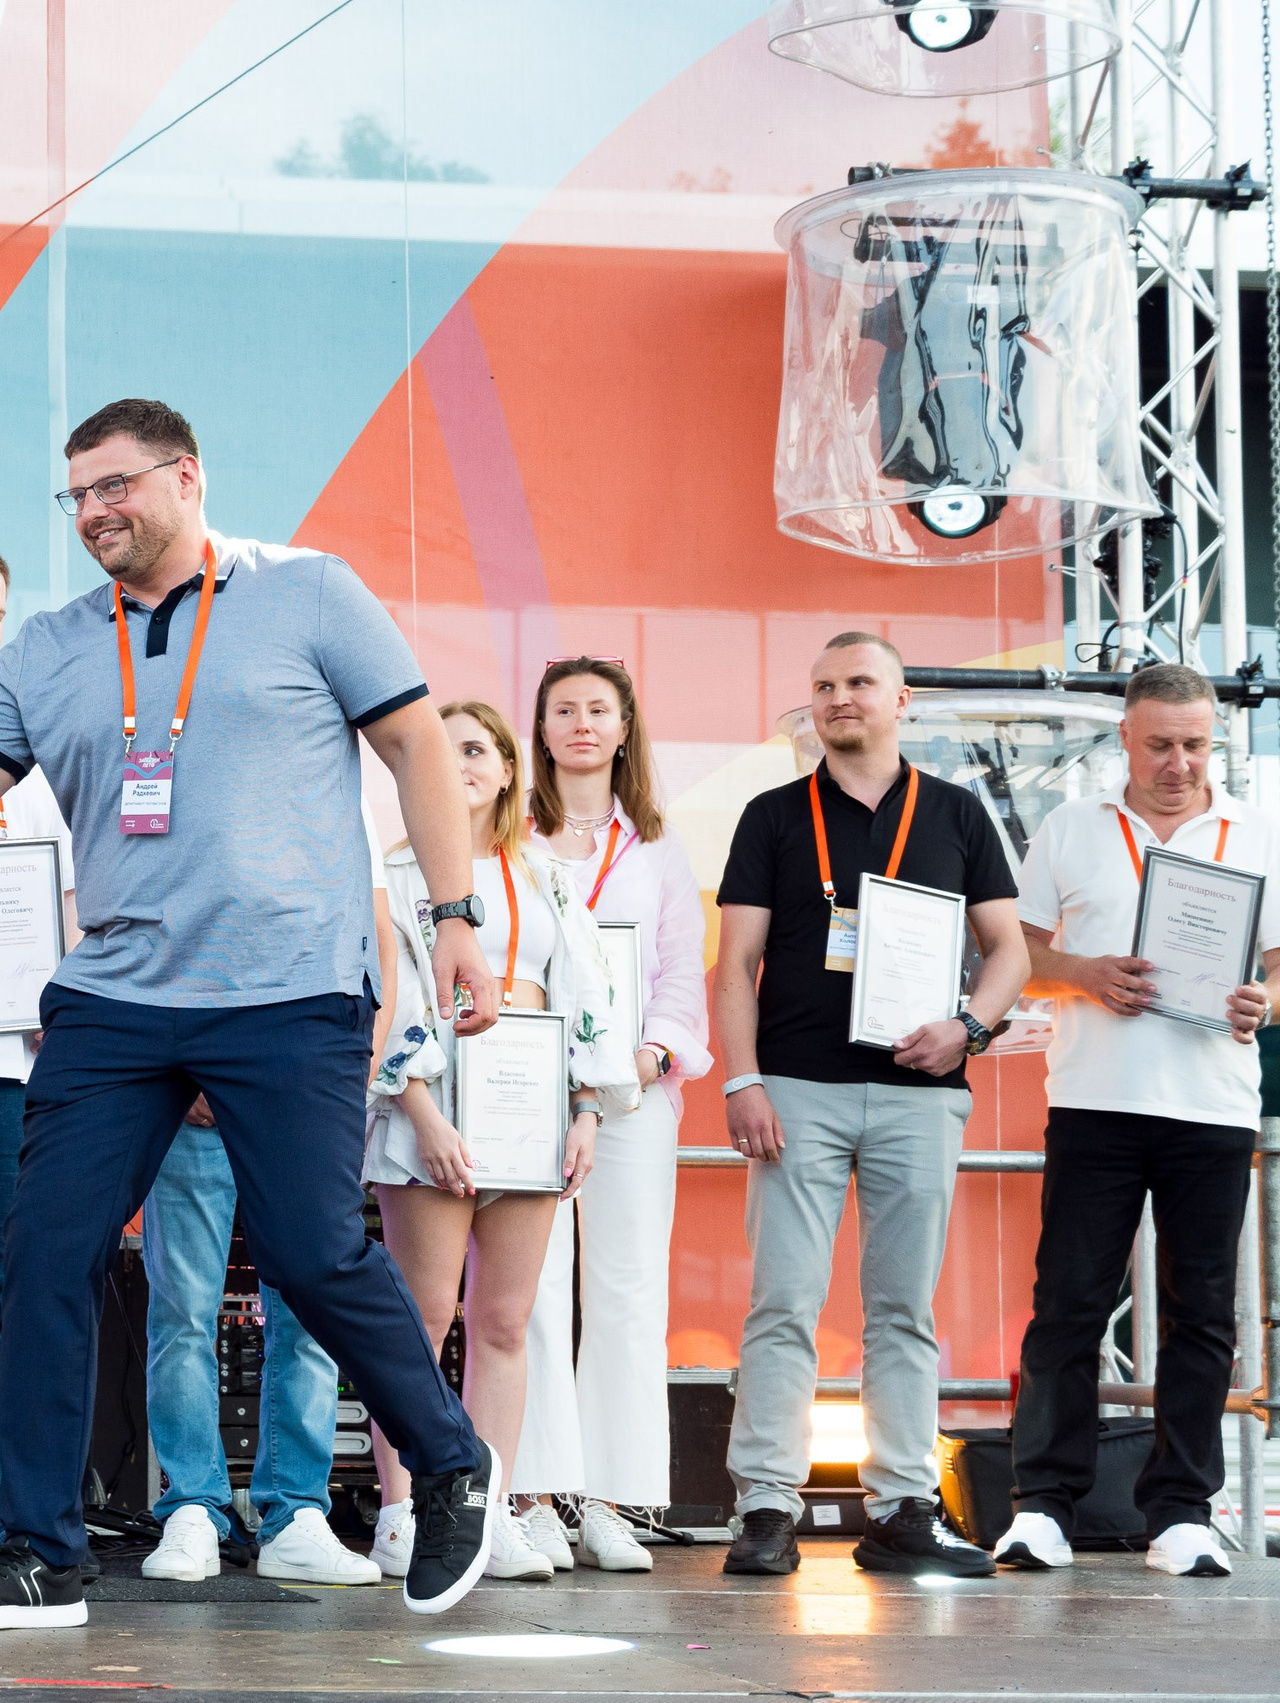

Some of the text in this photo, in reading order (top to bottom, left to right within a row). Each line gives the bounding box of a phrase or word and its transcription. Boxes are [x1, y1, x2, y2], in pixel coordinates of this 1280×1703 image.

[1167, 877, 1237, 903] Благодарность
[480, 1036, 545, 1050] Благодарность
[467, 1494, 485, 1505] BOSS
